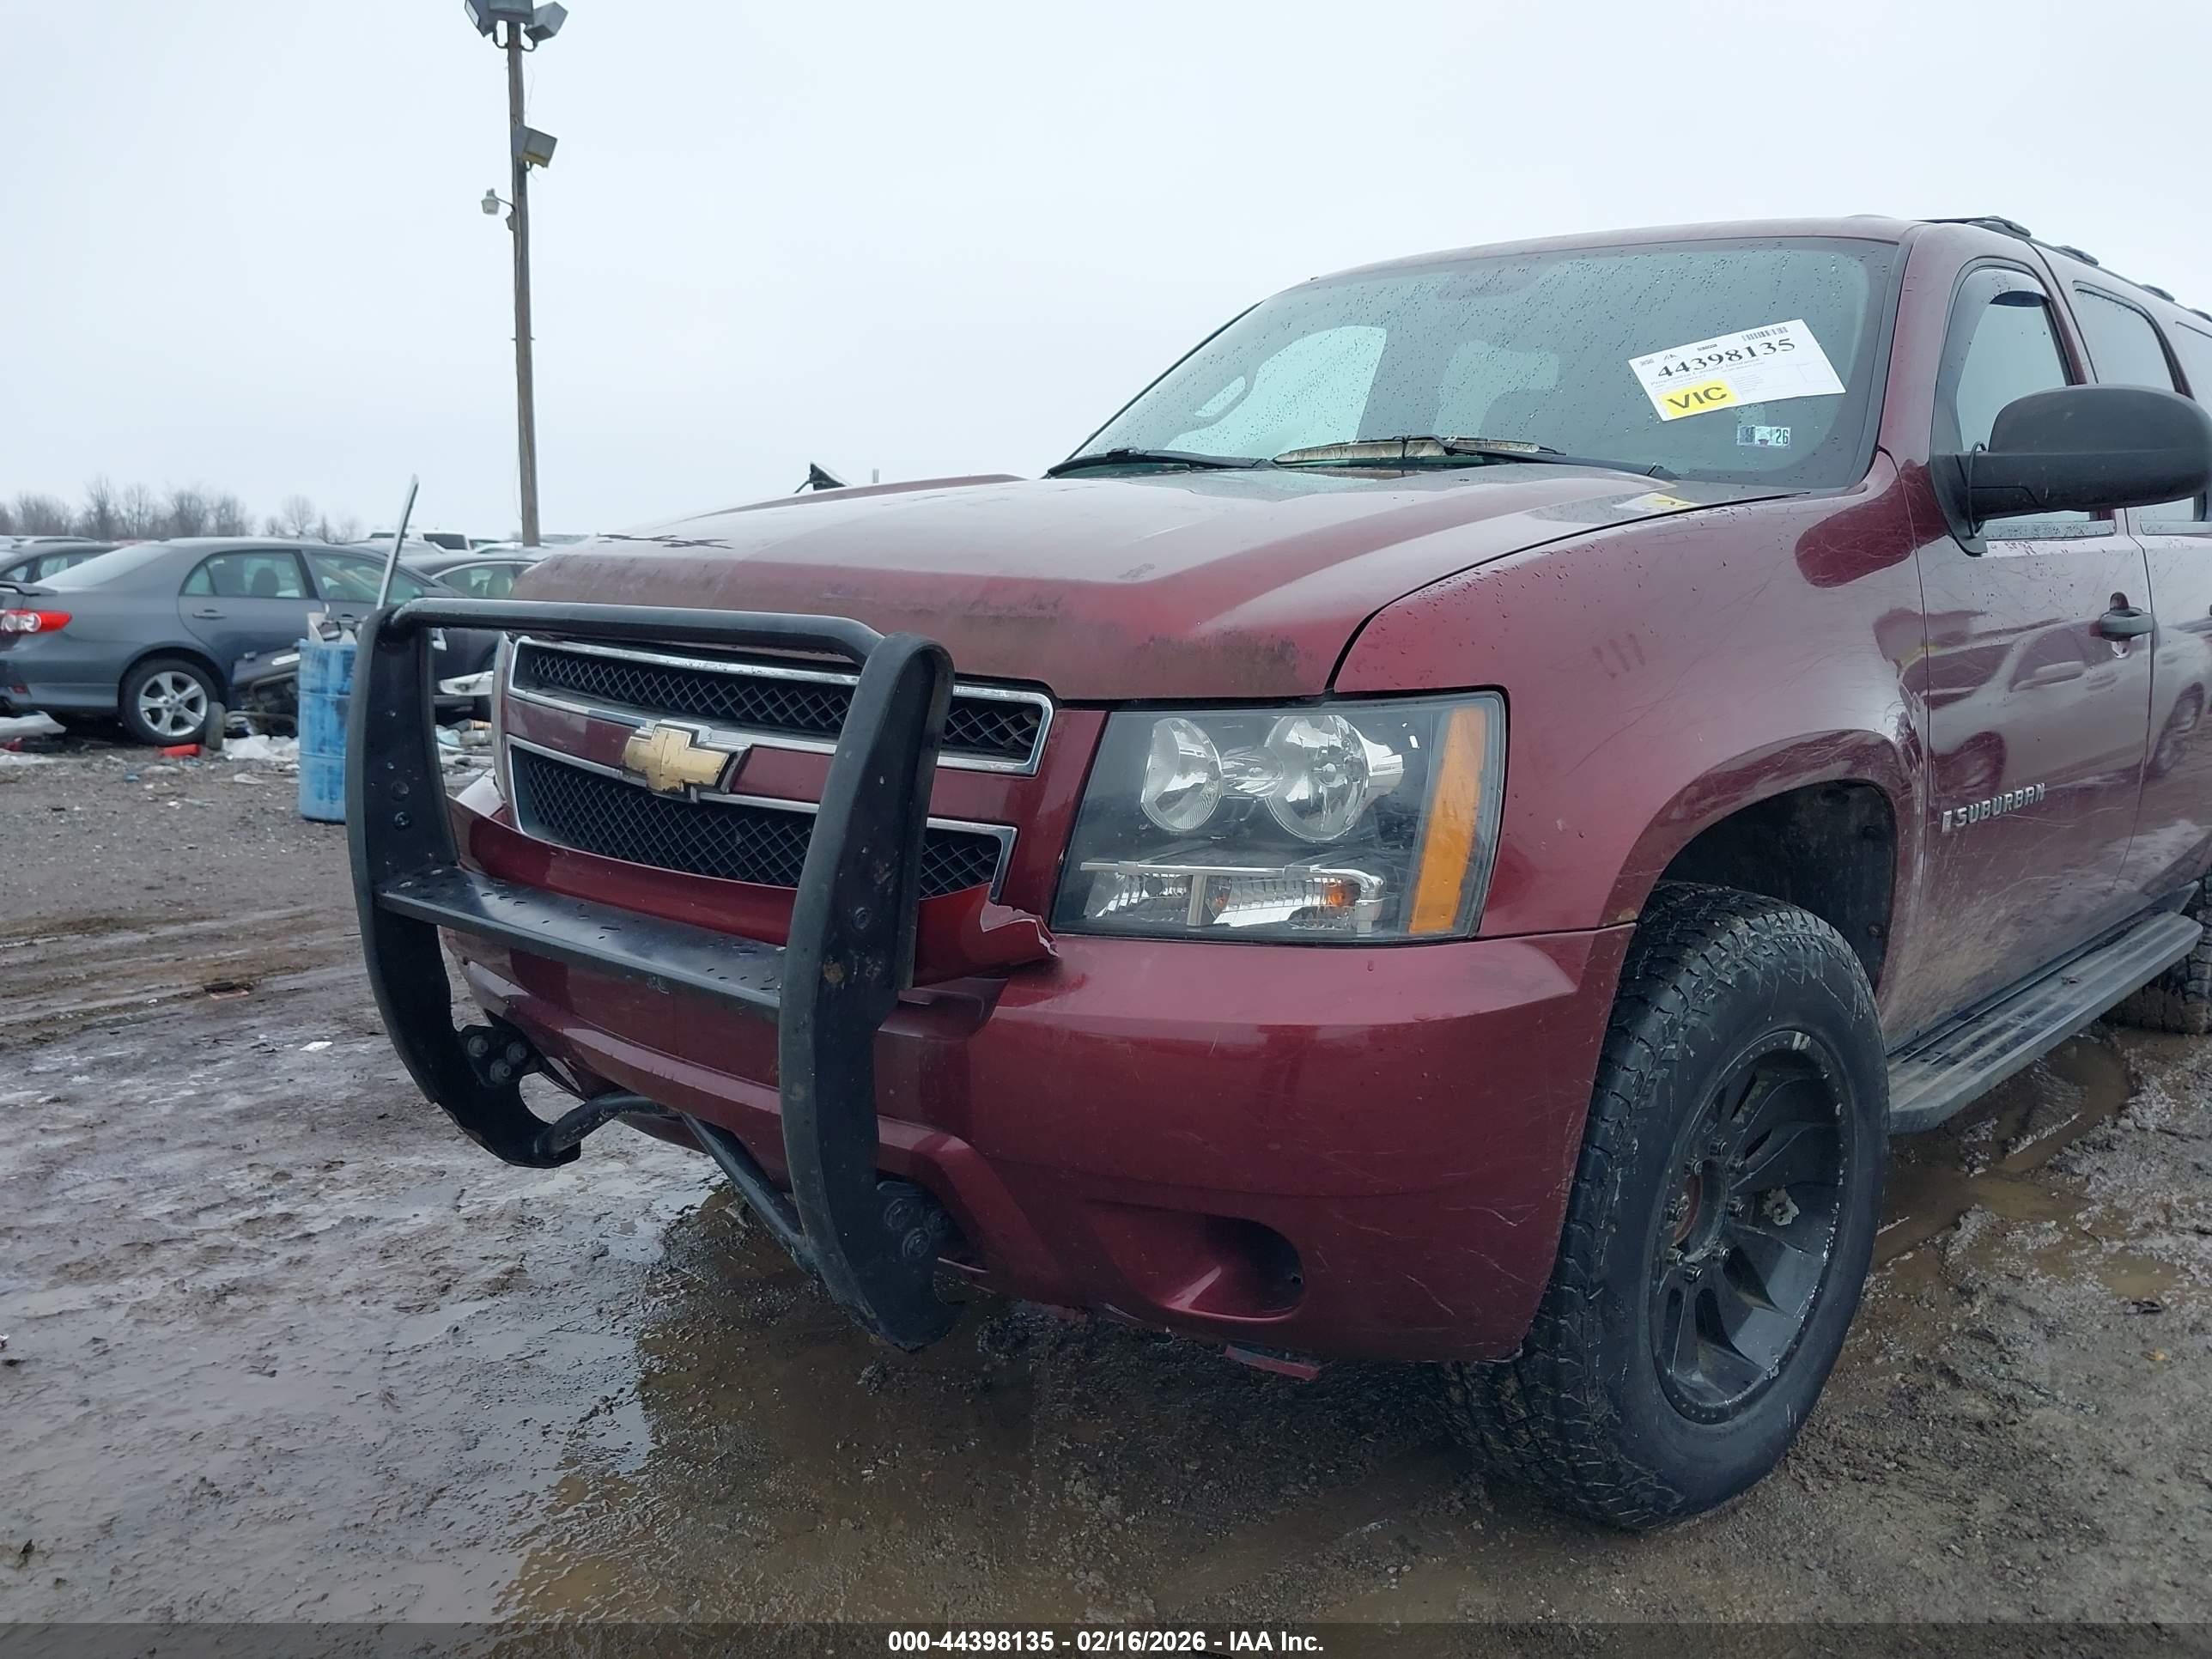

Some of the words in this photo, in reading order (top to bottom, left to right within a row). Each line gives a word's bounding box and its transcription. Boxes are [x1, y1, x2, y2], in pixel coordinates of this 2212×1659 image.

[1657, 337, 1796, 378] 44398135
[1667, 386, 1729, 410] VIC
[1775, 428, 1789, 444] 26
[1954, 782, 2045, 828] SUBURBAN
